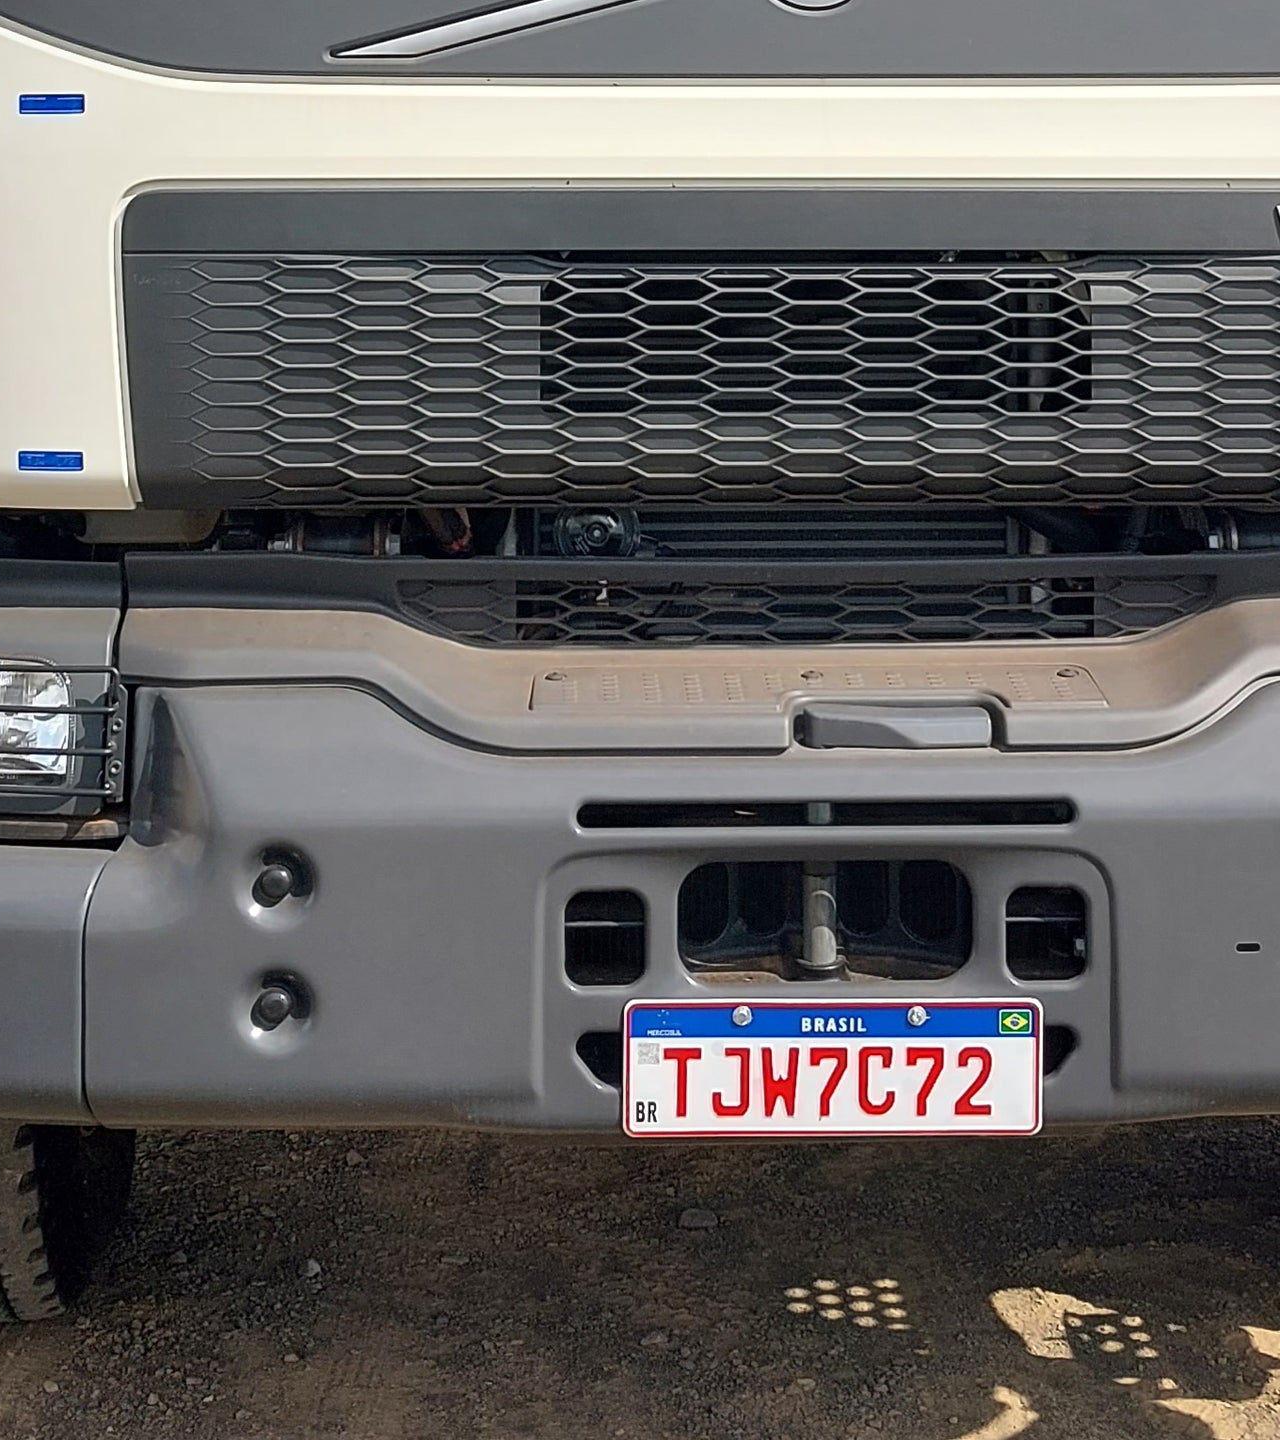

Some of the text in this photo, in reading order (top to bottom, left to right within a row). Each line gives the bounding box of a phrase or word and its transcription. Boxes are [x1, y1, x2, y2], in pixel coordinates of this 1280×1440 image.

[801, 1016, 867, 1033] BRASIL
[663, 1047, 993, 1118] TJW7C72
[635, 1101, 658, 1123] BR
